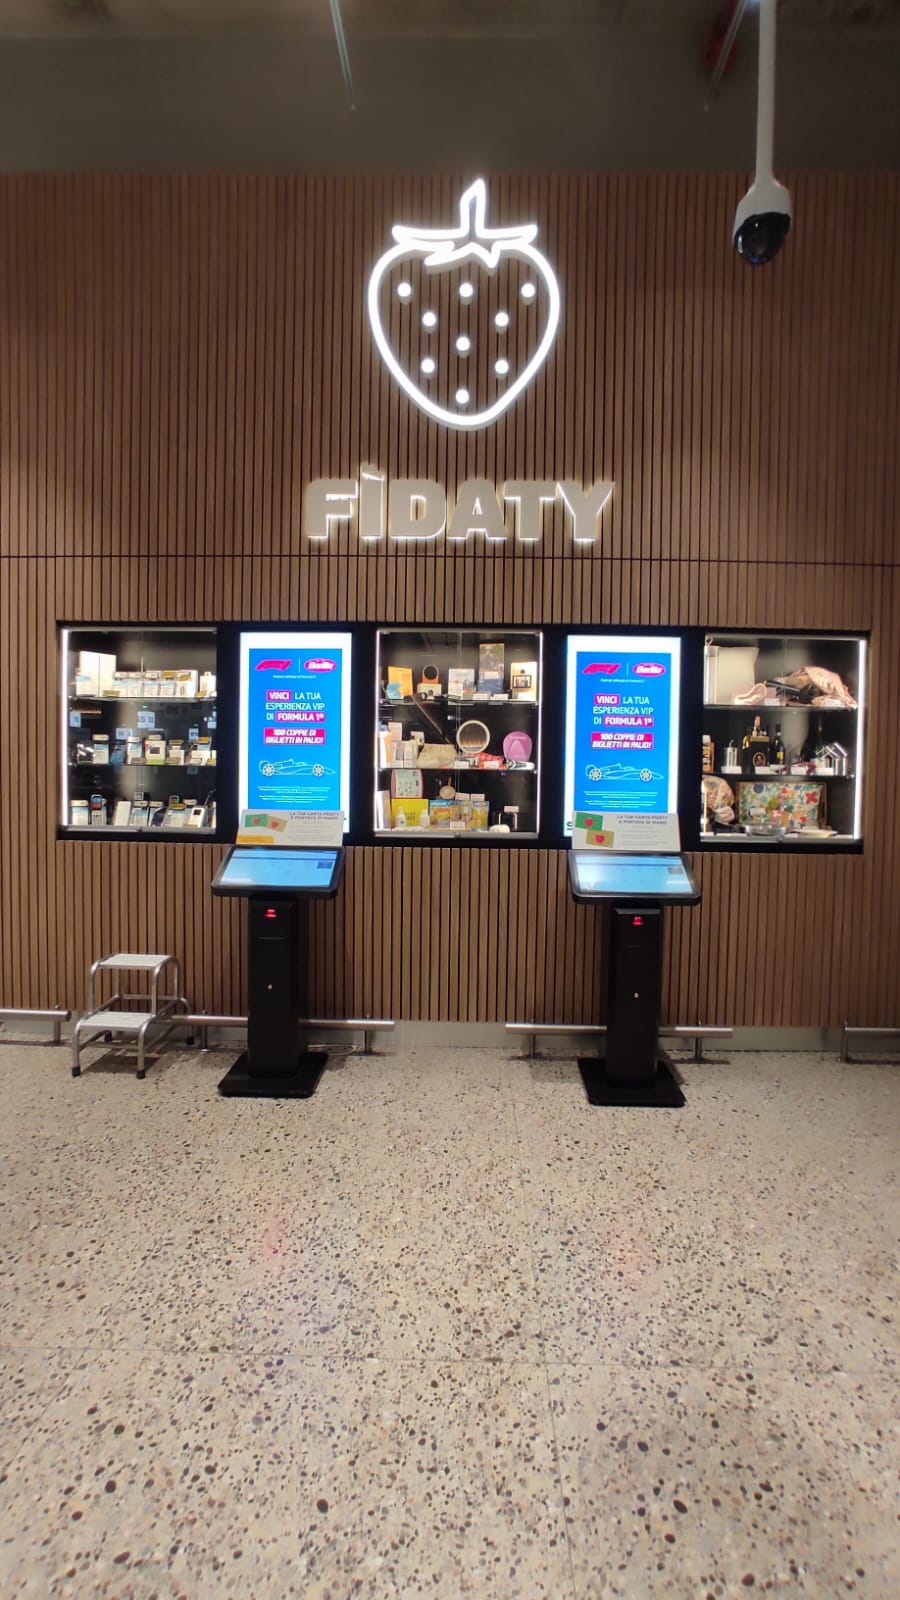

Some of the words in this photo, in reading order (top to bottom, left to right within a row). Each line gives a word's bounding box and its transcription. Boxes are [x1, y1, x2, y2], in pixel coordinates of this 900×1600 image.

[269, 692, 290, 700] VINCI
[294, 692, 305, 700] LA
[305, 692, 321, 700] TUA
[596, 695, 618, 704] VINCI
[622, 696, 633, 704] LA
[633, 696, 650, 704] TUA
[266, 702, 311, 710] ESPERIENZA
[592, 706, 640, 715] ESPERIENZA
[640, 707, 654, 715] VIP
[266, 712, 274, 720] DI
[277, 712, 314, 721] FORMULA
[593, 717, 602, 725] DI
[605, 717, 643, 726] FORMULA
